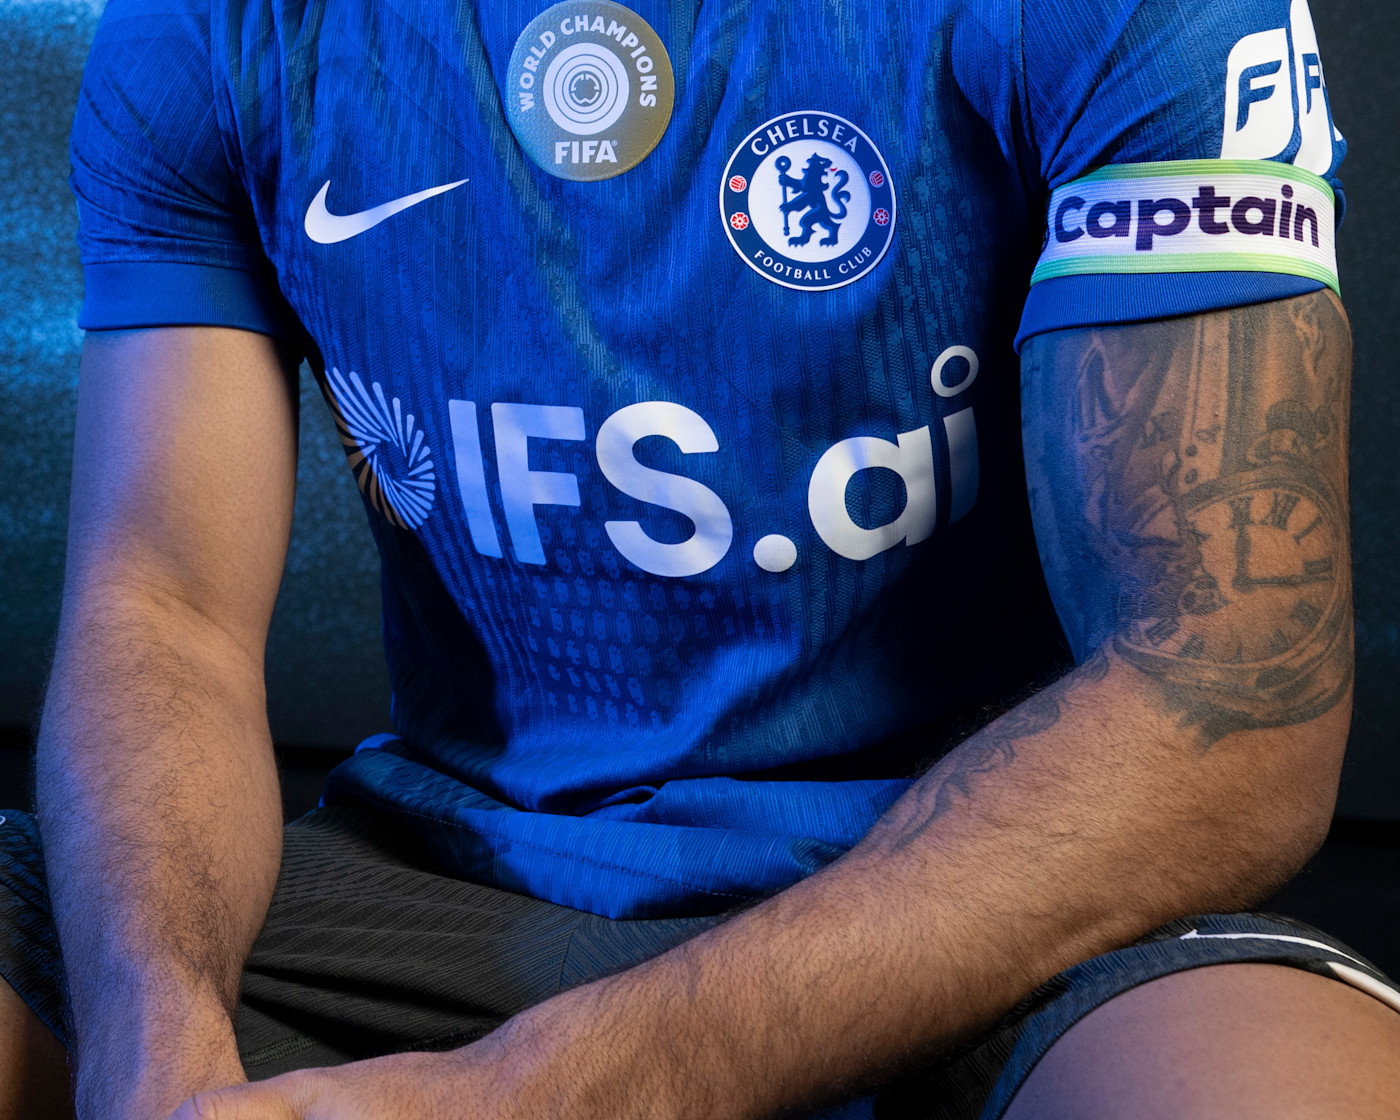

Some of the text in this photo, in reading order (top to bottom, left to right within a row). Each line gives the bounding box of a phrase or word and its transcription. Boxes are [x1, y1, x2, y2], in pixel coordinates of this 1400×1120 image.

[519, 14, 658, 113] WORLD CHAMPIONS
[751, 118, 858, 156] CHELSEA
[754, 246, 872, 280] FOOTBALL CLUB
[447, 344, 980, 578] IFS.ai
